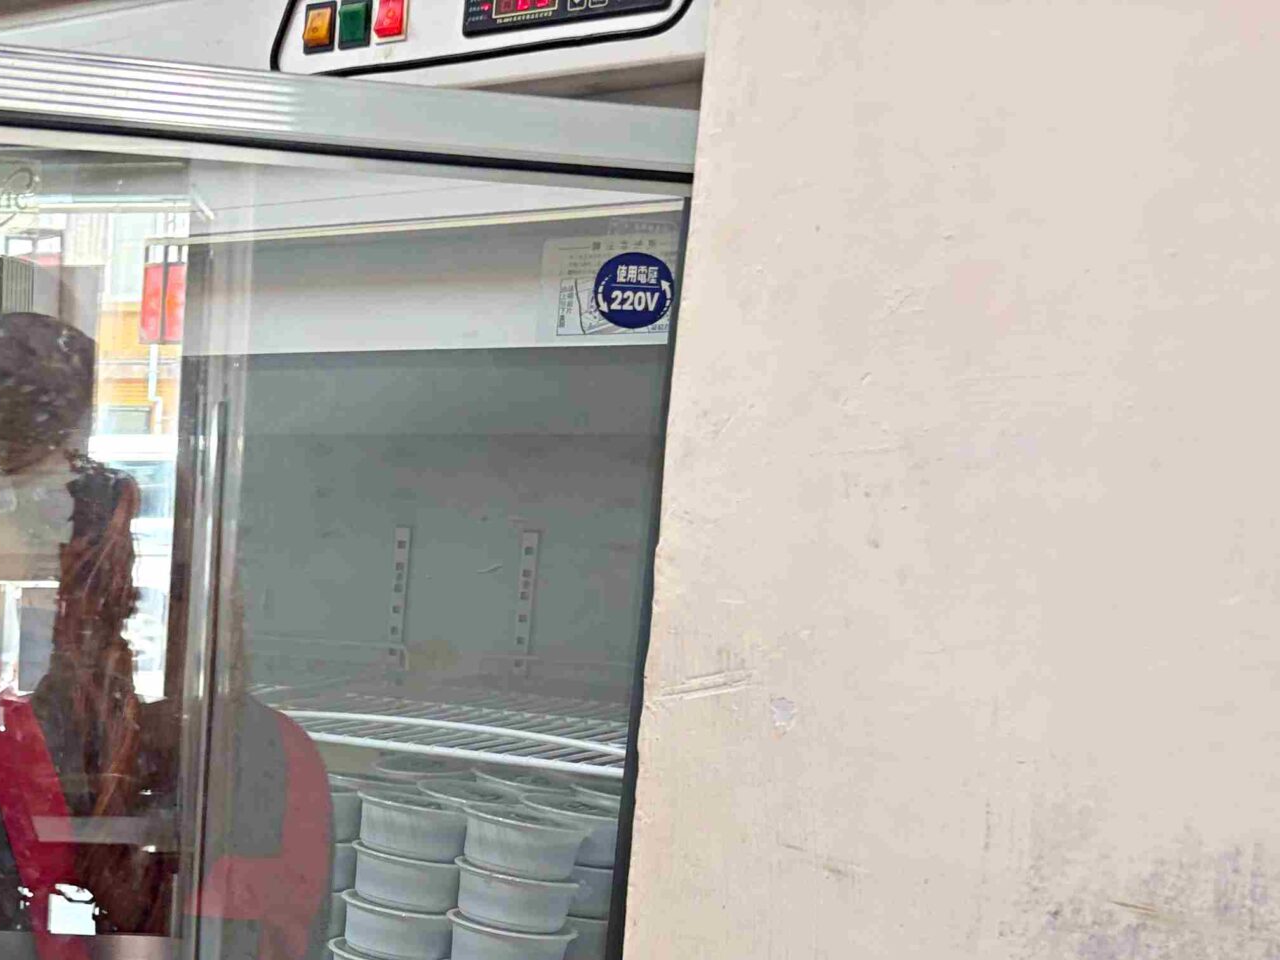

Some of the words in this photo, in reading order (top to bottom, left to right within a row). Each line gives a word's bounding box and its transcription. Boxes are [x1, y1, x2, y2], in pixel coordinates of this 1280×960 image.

[616, 265, 659, 284] 使用電壓
[610, 290, 660, 312] 220V
